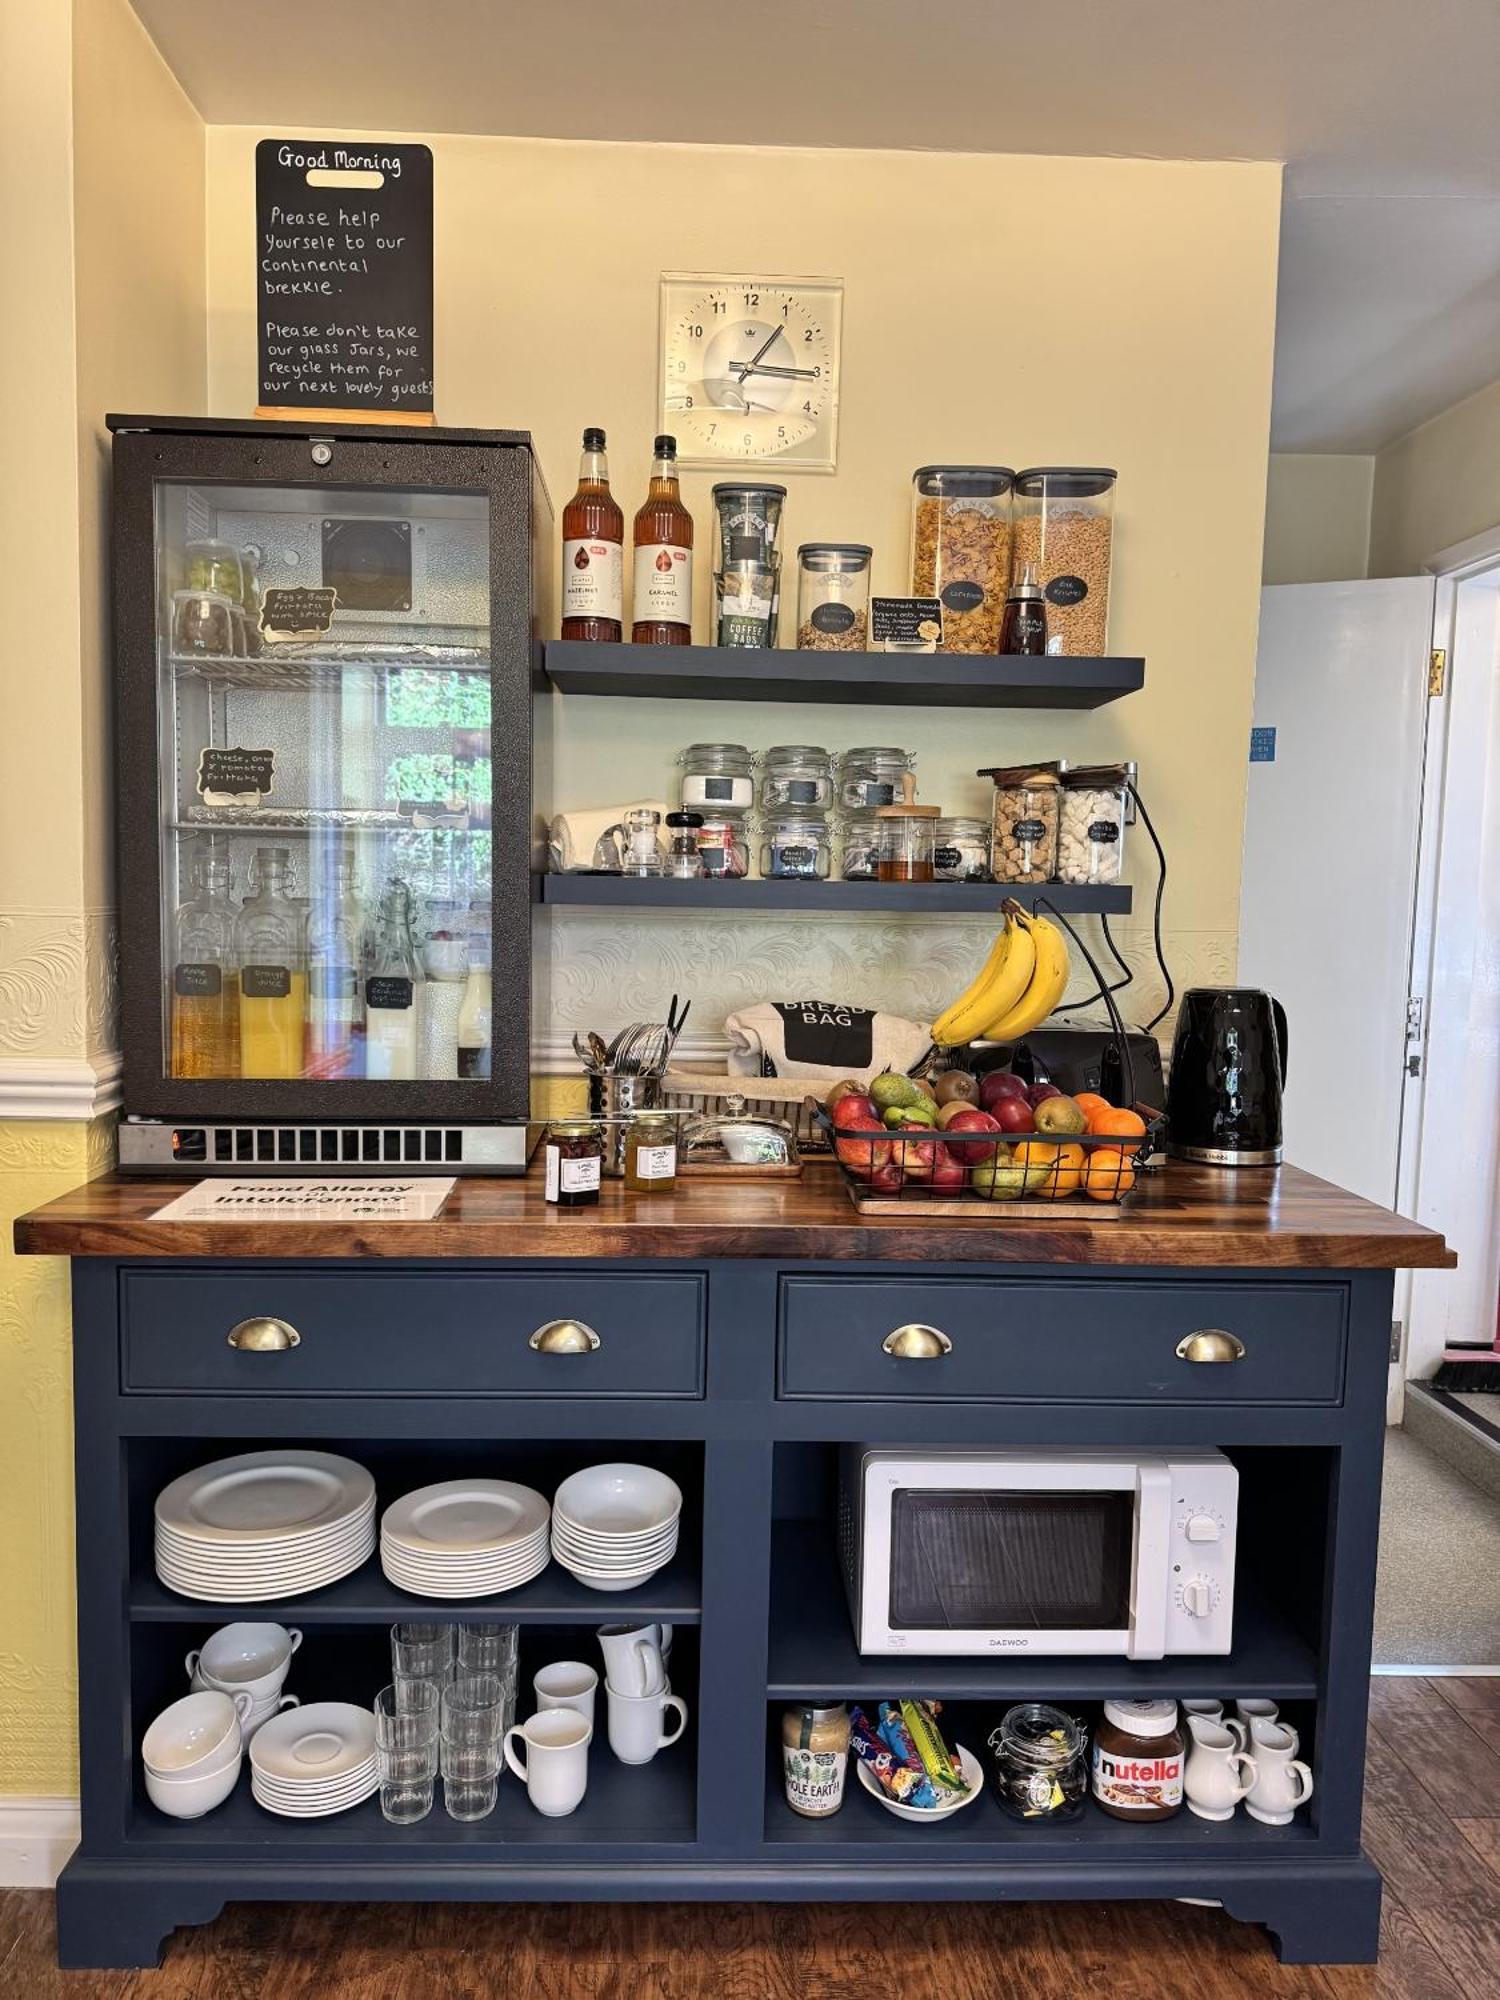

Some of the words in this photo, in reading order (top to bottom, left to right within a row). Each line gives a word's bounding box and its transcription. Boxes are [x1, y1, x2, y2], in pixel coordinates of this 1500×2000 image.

[278, 146, 328, 168] Good
[335, 150, 401, 178] Morning
[271, 206, 330, 226] Please
[339, 208, 380, 229] help
[345, 234, 365, 249] to
[376, 237, 406, 249] our
[743, 294, 759, 306] 12
[712, 302, 727, 314] 11
[782, 305, 788, 317] 1
[266, 322, 320, 338] Please
[326, 323, 371, 338] don't
[377, 325, 420, 338] take
[688, 326, 703, 337] 10
[804, 330, 813, 342] 2
[268, 345, 293, 356] our
[300, 343, 339, 361] glass
[396, 346, 419, 357] we
[269, 361, 323, 379] recycle
[330, 362, 370, 374] them
[378, 365, 403, 378] for
[678, 361, 686, 373] 9
[813, 366, 821, 378] 3
[263, 379, 291, 391] our
[300, 380, 338, 393] next
[345, 380, 383, 398] lovely
[803, 401, 812, 413] 4
[709, 424, 717, 435] 7
[778, 426, 785, 438] 5
[744, 433, 751, 446] 6
[730, 624, 763, 636] COFFEE
[783, 1001, 866, 1015] BREAD
[803, 1012, 852, 1027] BAG
[989, 1639, 1029, 1647] DAEWOO
[1102, 1759, 1179, 1782] nutella
[810, 1781, 840, 1798] EARTH
